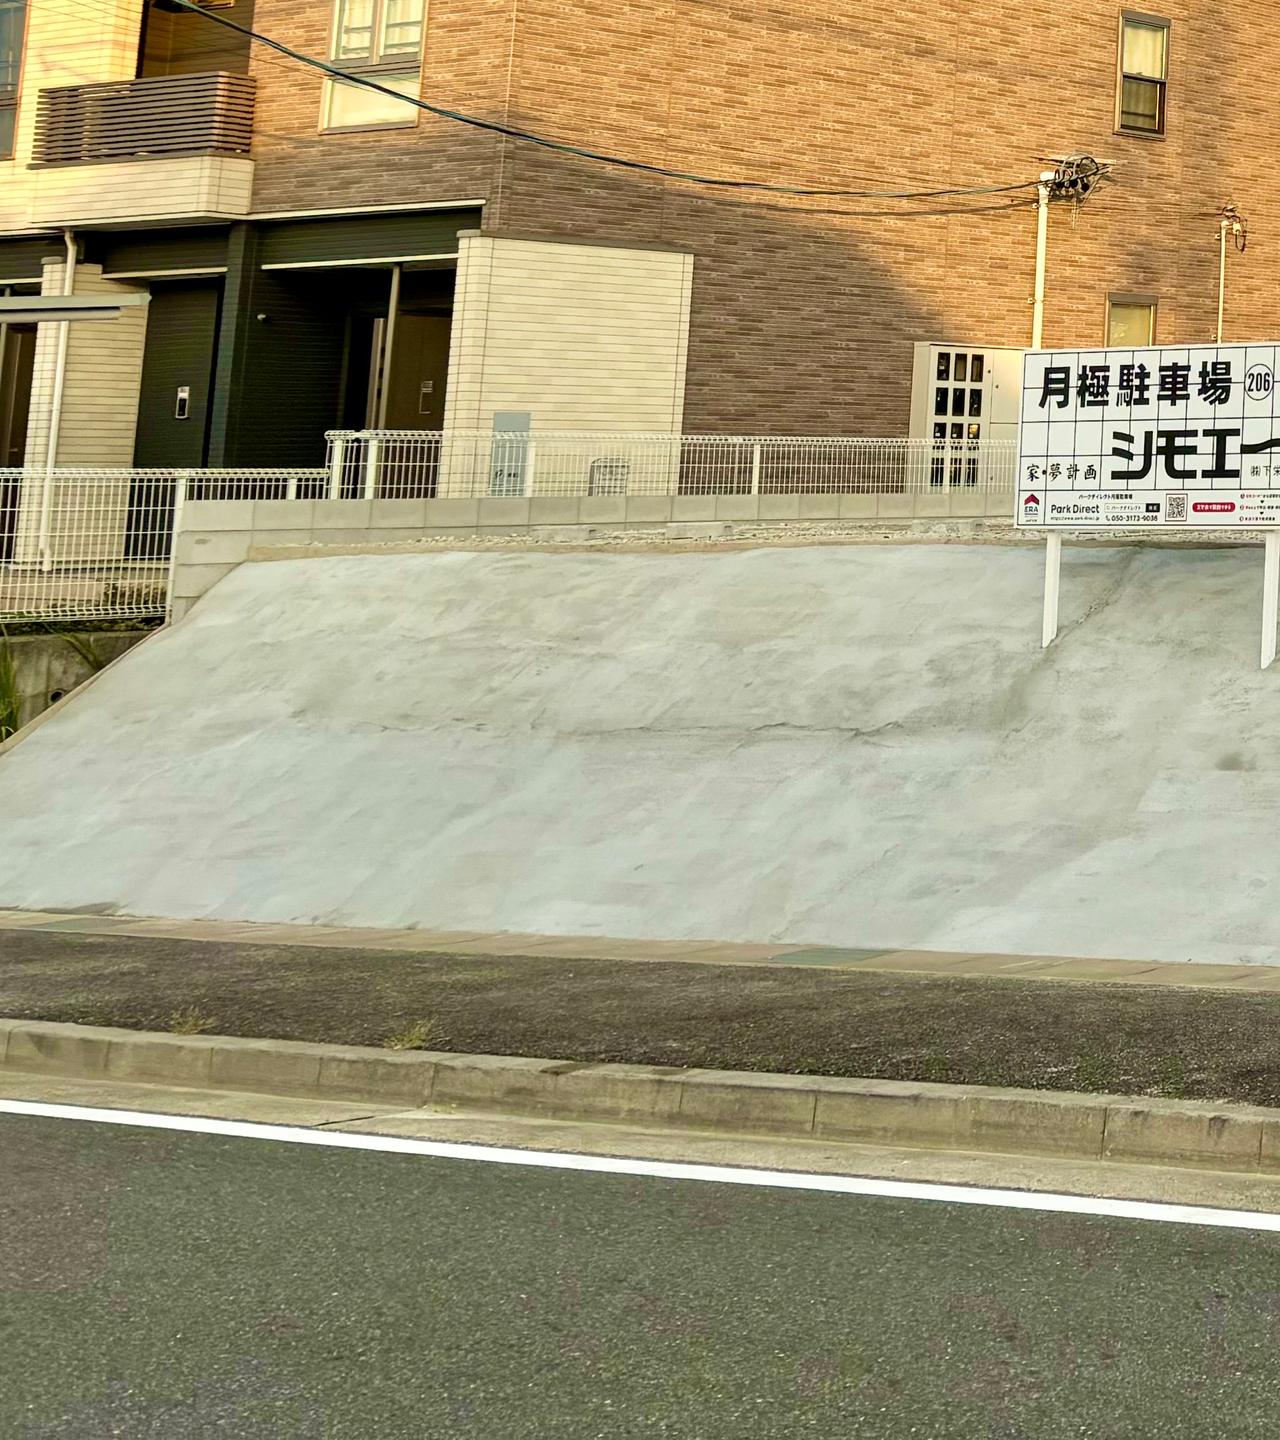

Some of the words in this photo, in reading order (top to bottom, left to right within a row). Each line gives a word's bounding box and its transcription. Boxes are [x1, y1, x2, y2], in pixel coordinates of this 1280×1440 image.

[1038, 361, 1232, 408] 月極駐車場
[1247, 372, 1270, 392] 206
[1050, 504, 1071, 514] Park
[1072, 504, 1100, 514] Direct
